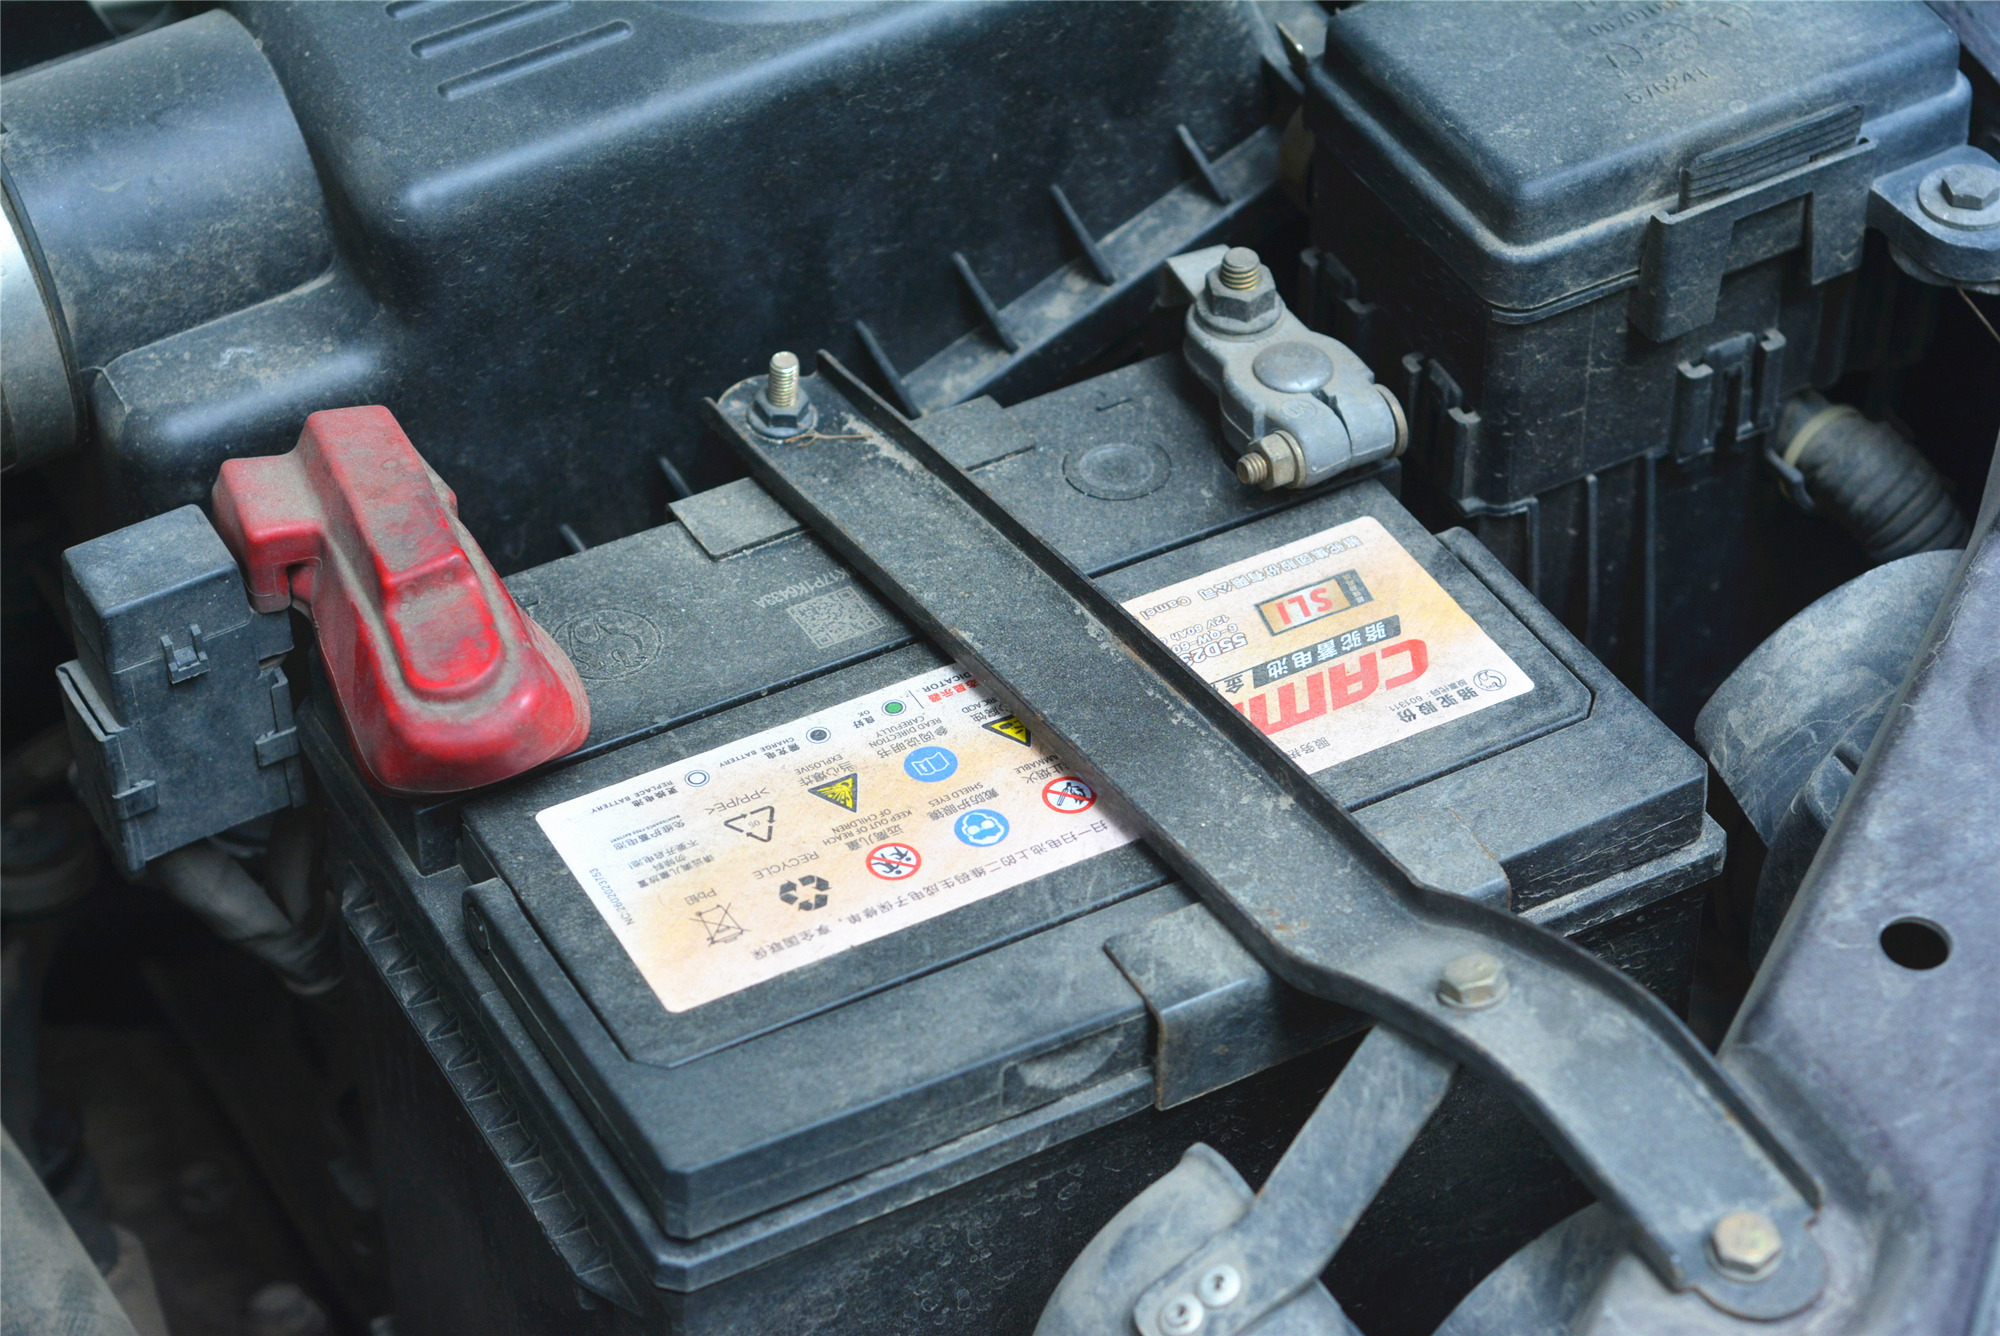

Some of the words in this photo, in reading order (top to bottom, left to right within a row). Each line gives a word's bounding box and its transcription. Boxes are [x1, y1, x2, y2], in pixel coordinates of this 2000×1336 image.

[1192, 534, 1366, 600] 骆驼集团股份有限公司
[1139, 596, 1192, 621] Camel
[1275, 587, 1334, 626] SLI
[1170, 623, 1203, 642] 60Ah
[1206, 614, 1230, 630] 12V
[1266, 621, 1387, 680] 骆驼蓄电池
[1233, 638, 1429, 735] CAM
[959, 701, 984, 714] ACID
[1392, 685, 1480, 723] 骆驼股份
[849, 714, 877, 729] 良好
[872, 714, 927, 738] CAREFULLY
[914, 716, 942, 730] READ
[757, 735, 795, 752] CHARGE
[866, 726, 918, 748] DIRECTION
[873, 725, 951, 758] 参阅说明书
[716, 749, 758, 768] BATTERY
[762, 742, 801, 760] 需充电
[792, 753, 844, 775] EXPLOSIVE
[795, 760, 856, 788] 当心爆炸
[1019, 760, 1072, 785] 止烟火
[629, 785, 678, 807] 更换电池
[632, 779, 673, 797] REPLACE
[948, 781, 985, 798] SHIELD
[589, 795, 630, 813] BATTERY
[702, 785, 771, 816] >PP/PE<
[924, 787, 1002, 821] 戴防护眼镜
[926, 794, 952, 807] EYES
[829, 812, 878, 834] CHILDREN
[867, 817, 889, 829] OUT
[875, 807, 892, 817] OF
[887, 808, 913, 821] KEEP
[611, 818, 687, 851] 免维护蓄电池
[820, 830, 854, 846] REACH
[842, 823, 905, 851] 远离儿童
[852, 824, 869, 834] OF
[635, 853, 716, 888] 请远离儿童放置
[750, 849, 820, 880] RECYCLE
